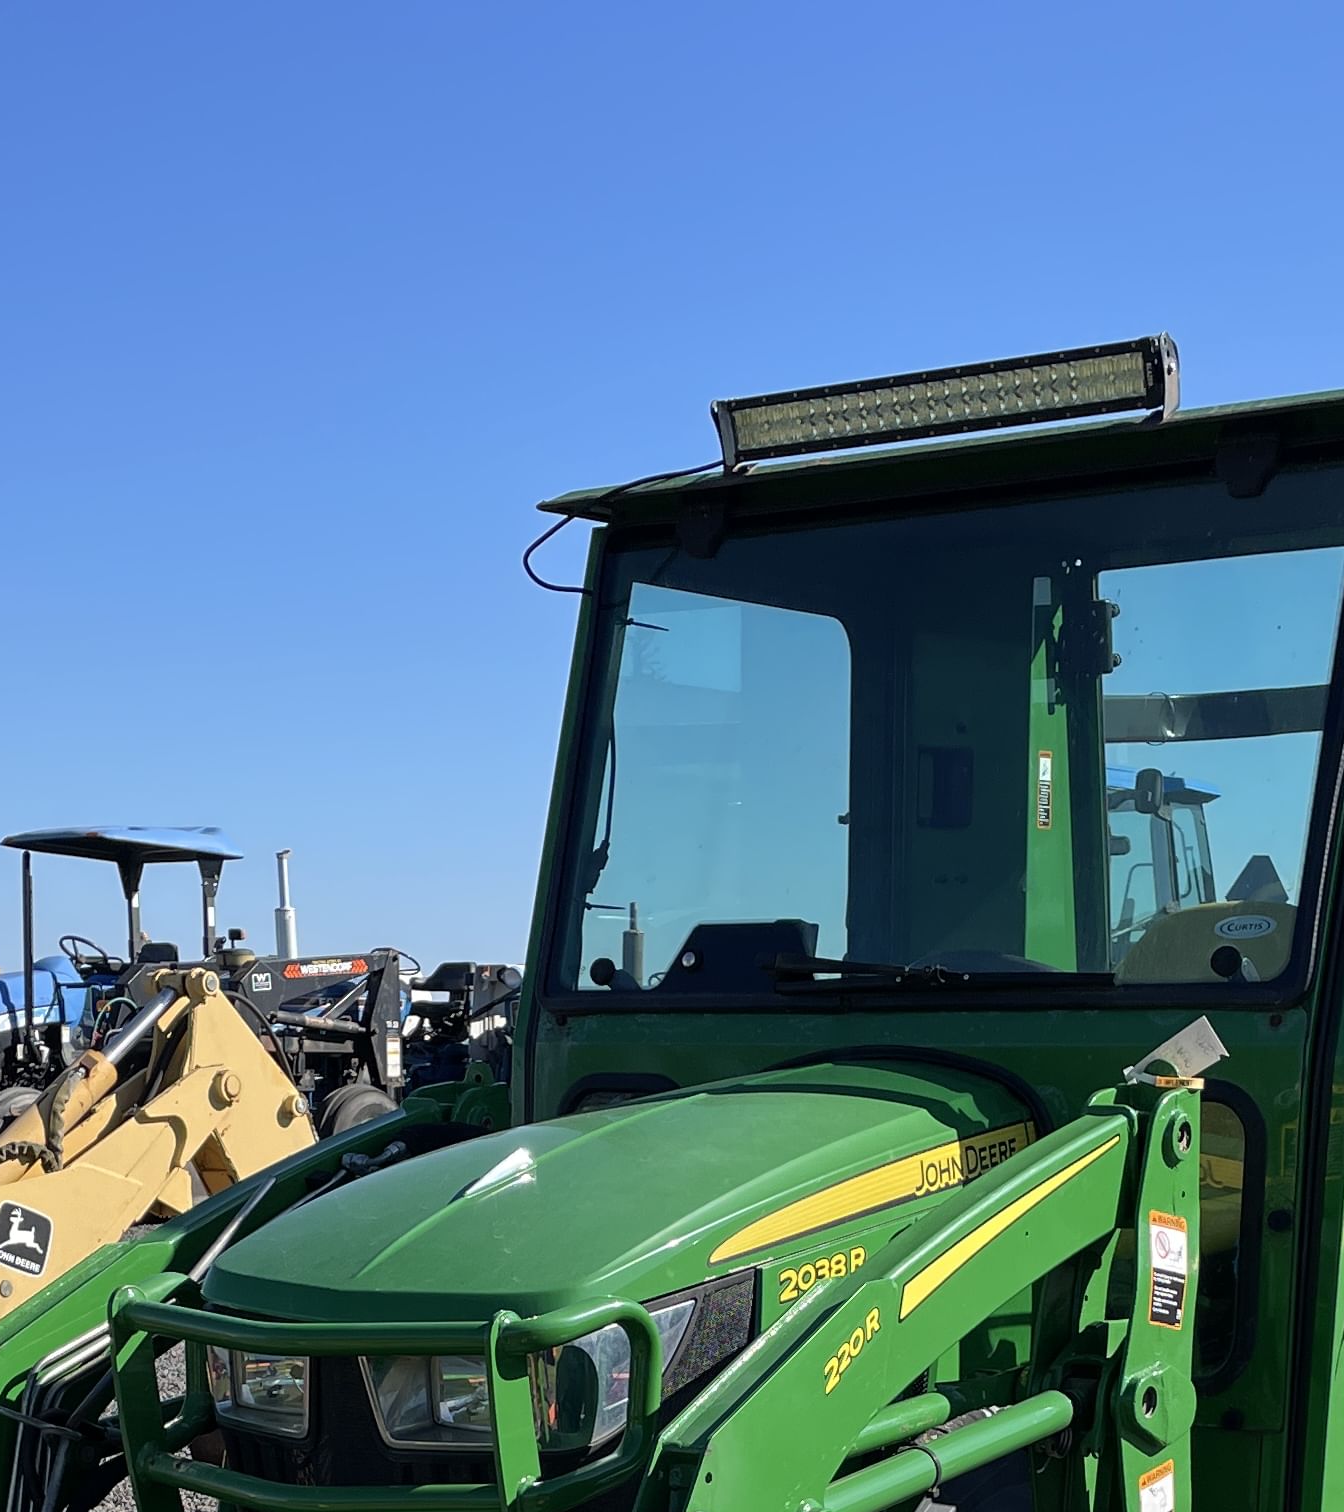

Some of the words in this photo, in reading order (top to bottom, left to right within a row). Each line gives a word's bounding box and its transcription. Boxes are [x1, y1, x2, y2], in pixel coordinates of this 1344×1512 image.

[1227, 922, 1264, 933] CURTIS
[300, 962, 353, 975] WESTENDORF
[916, 1157, 965, 1191] JOHN
[965, 1138, 1016, 1177] DEERE
[15, 1256, 41, 1273] DEERE
